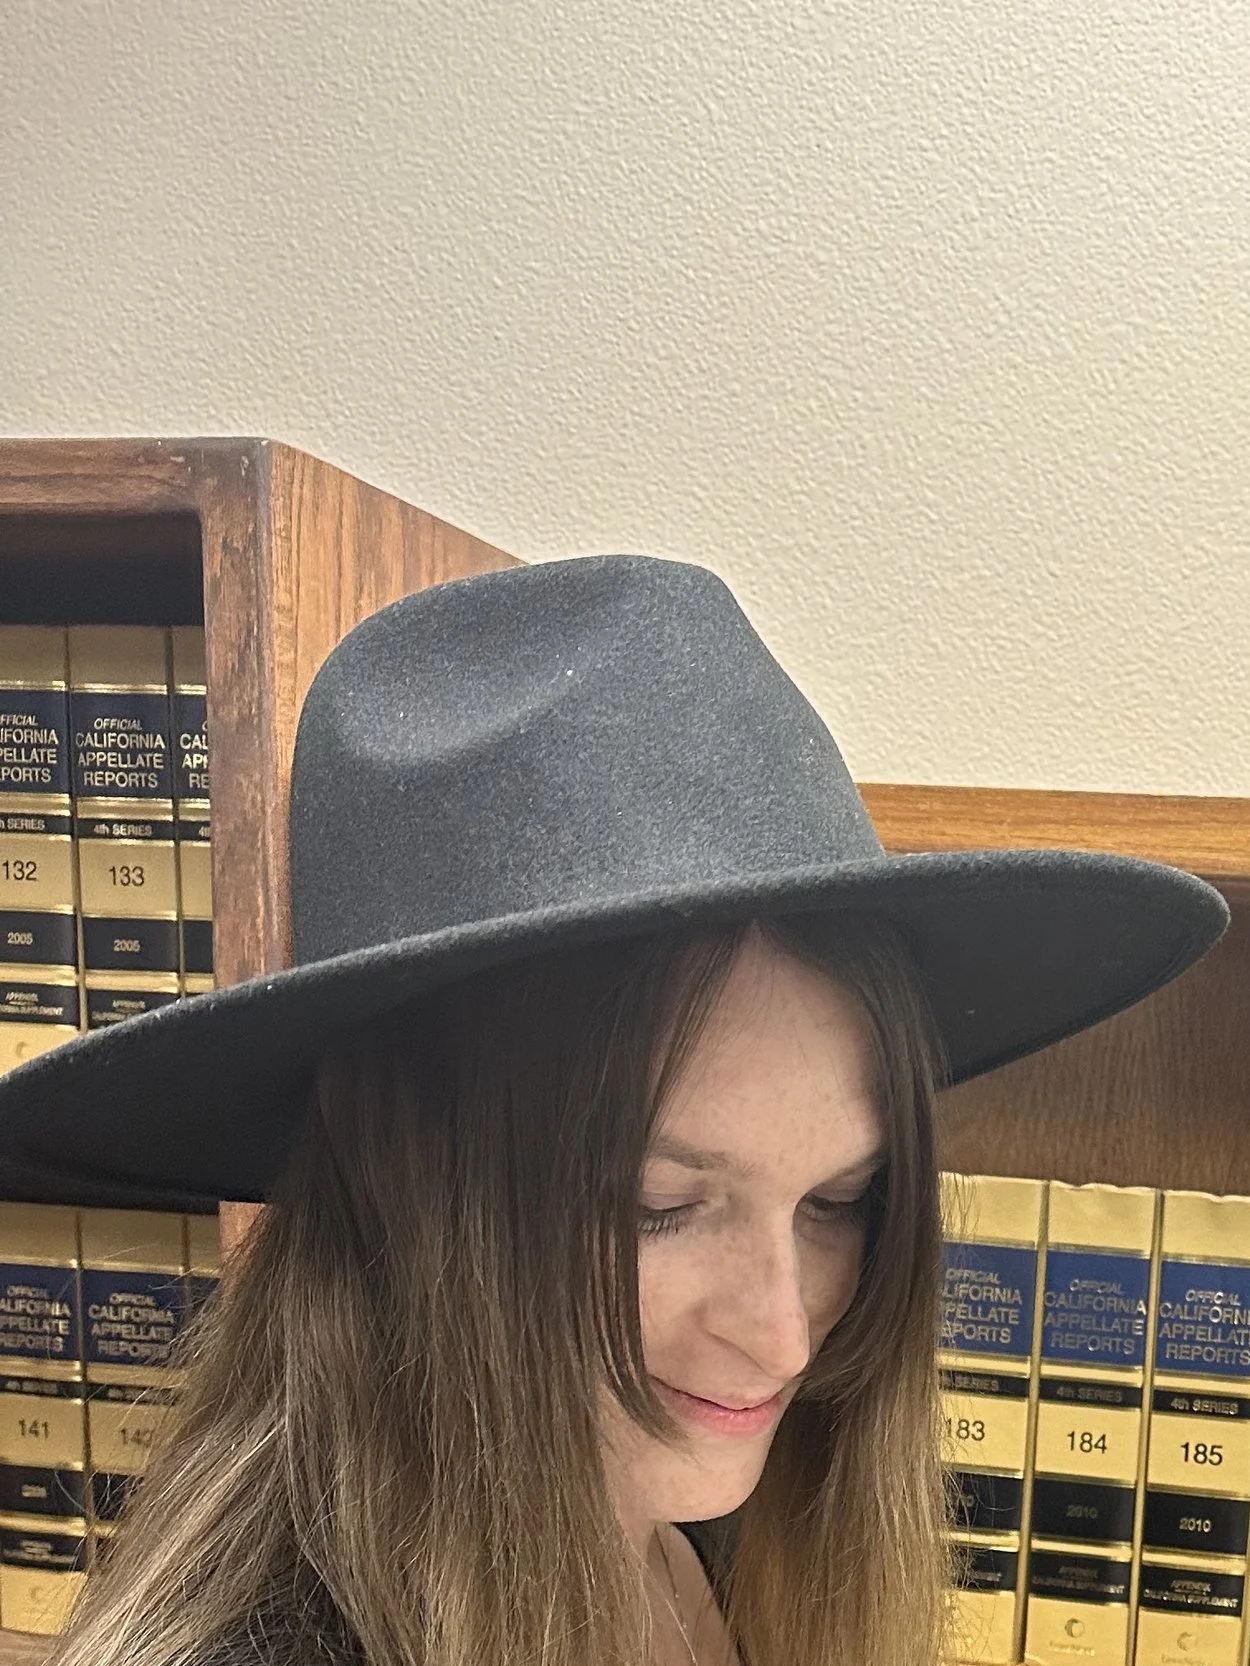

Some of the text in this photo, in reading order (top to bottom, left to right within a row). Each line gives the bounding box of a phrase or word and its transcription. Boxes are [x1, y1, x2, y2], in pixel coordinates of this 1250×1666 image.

[76, 733, 165, 749] CALIFORNIA
[78, 753, 164, 768] APPELLATE
[84, 772, 158, 788] REPORTS
[2, 860, 37, 881] 132
[108, 866, 144, 887] 133
[1044, 1292, 1147, 1315] CALIFORNIA
[88, 1305, 174, 1325] CALIFORNIA
[1044, 1312, 1144, 1336] APPELLATE
[91, 1324, 173, 1342] APPELLATE
[1052, 1333, 1135, 1355] REPORTS
[1166, 1344, 1250, 1366] REPORTS
[18, 1419, 48, 1439] 141
[1066, 1431, 1107, 1454] 184
[1180, 1442, 1223, 1466] 185
